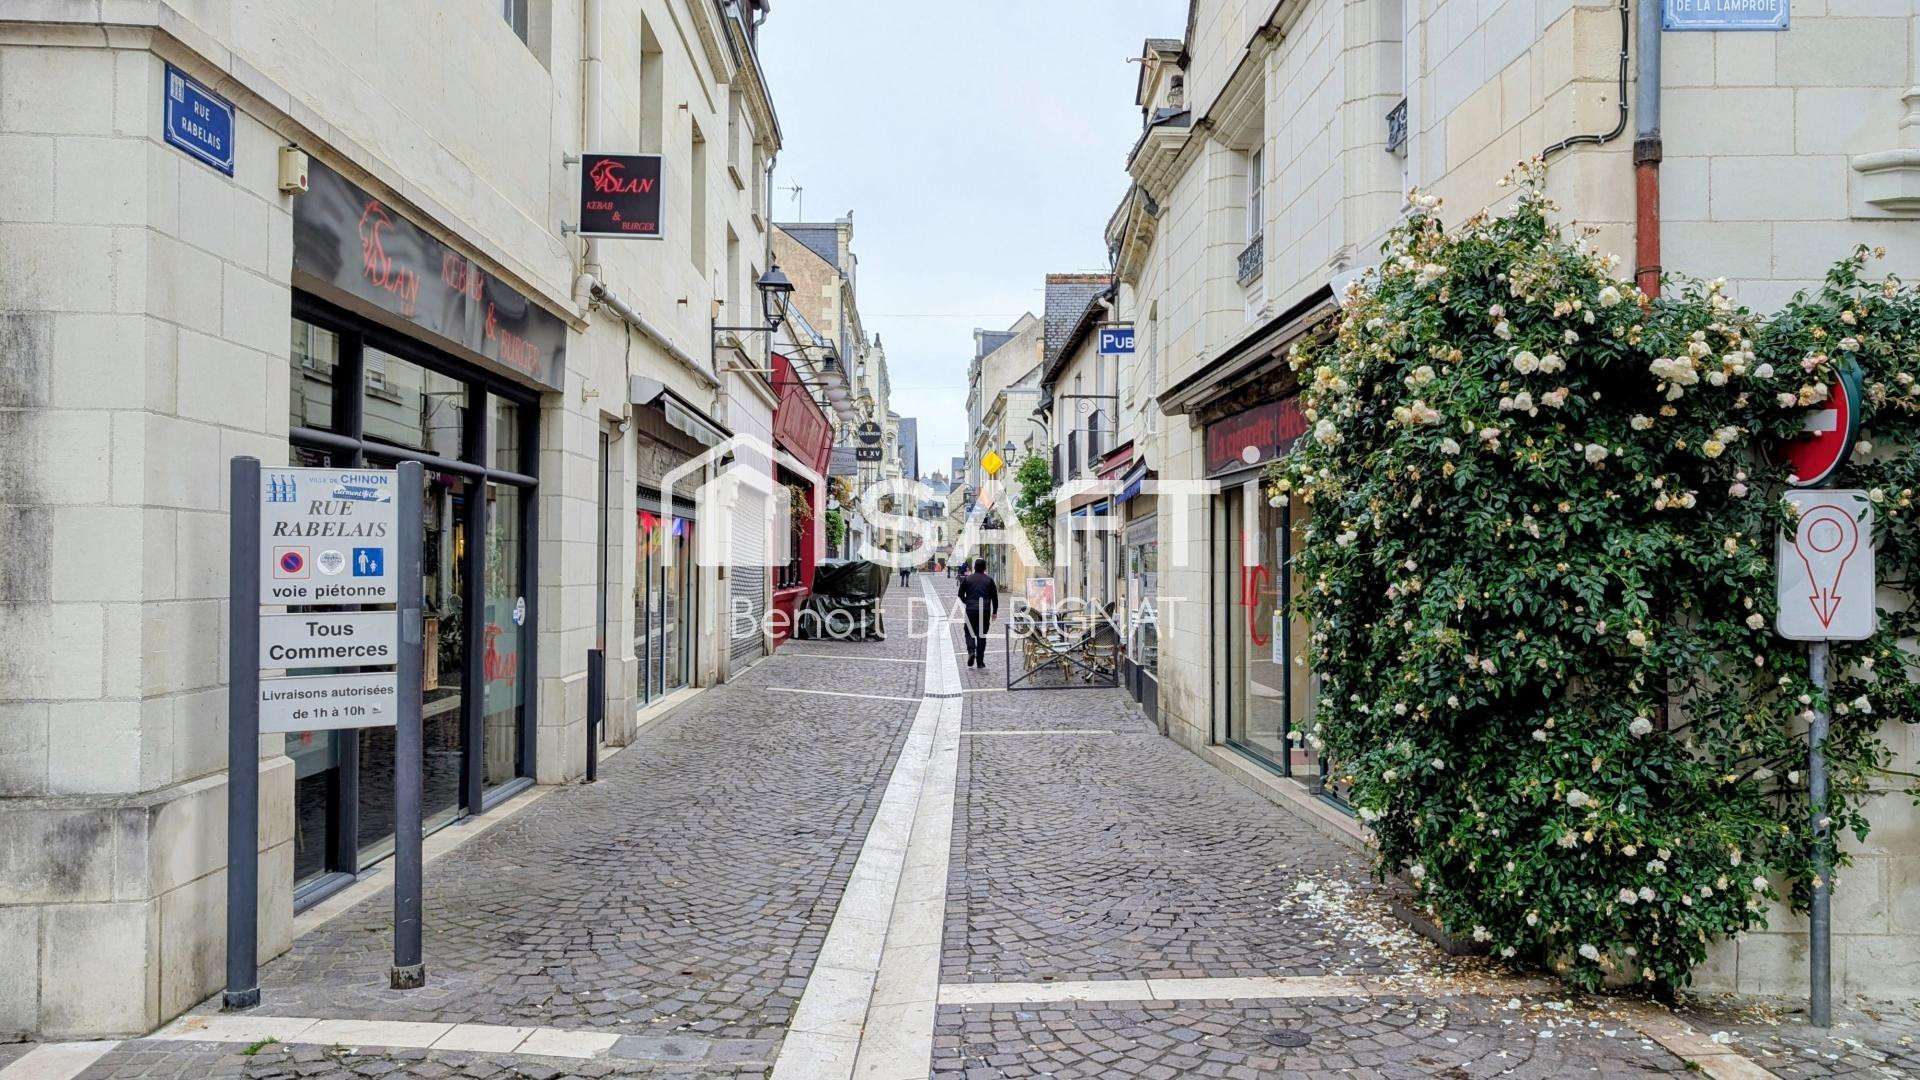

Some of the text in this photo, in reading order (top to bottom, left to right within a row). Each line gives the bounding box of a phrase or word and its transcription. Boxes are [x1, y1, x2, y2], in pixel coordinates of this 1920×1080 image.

[1676, 0, 1777, 12] DE LA LAMPROIE
[194, 100, 210, 121] RUE
[181, 116, 221, 151] RABELAIS
[586, 201, 613, 211] KEBAB
[612, 211, 622, 221] &
[622, 221, 656, 231] BURGER
[441, 252, 484, 301] KEBAB
[486, 302, 497, 341] &
[501, 329, 544, 375] BURGER
[340, 474, 388, 485] CHINON
[308, 500, 354, 516] RUE
[272, 521, 388, 537] RABELAIS
[273, 583, 386, 599] voie piétonne
[306, 621, 354, 637] Tous
[269, 643, 388, 661] Commerces
[262, 684, 394, 701] Livraisons autorisées
[292, 705, 365, 720] de 1h à 10h
